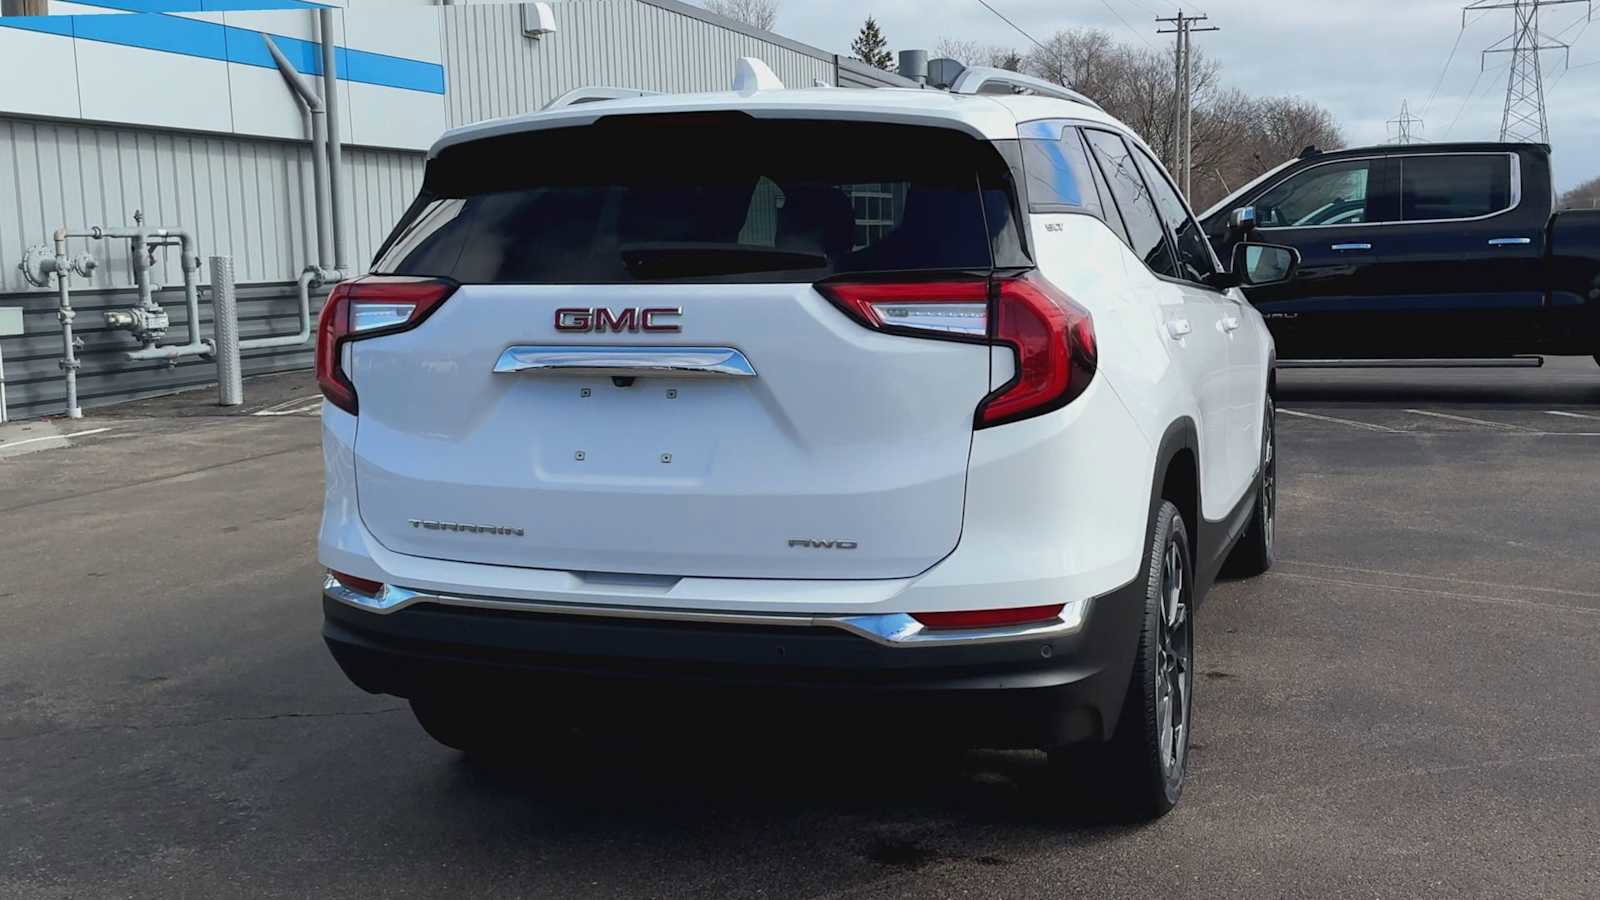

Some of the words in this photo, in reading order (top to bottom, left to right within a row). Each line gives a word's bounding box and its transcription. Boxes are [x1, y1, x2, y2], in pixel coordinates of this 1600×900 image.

[554, 306, 683, 333] GMC
[408, 518, 524, 536] TERRAIN
[787, 538, 858, 549] AWD
